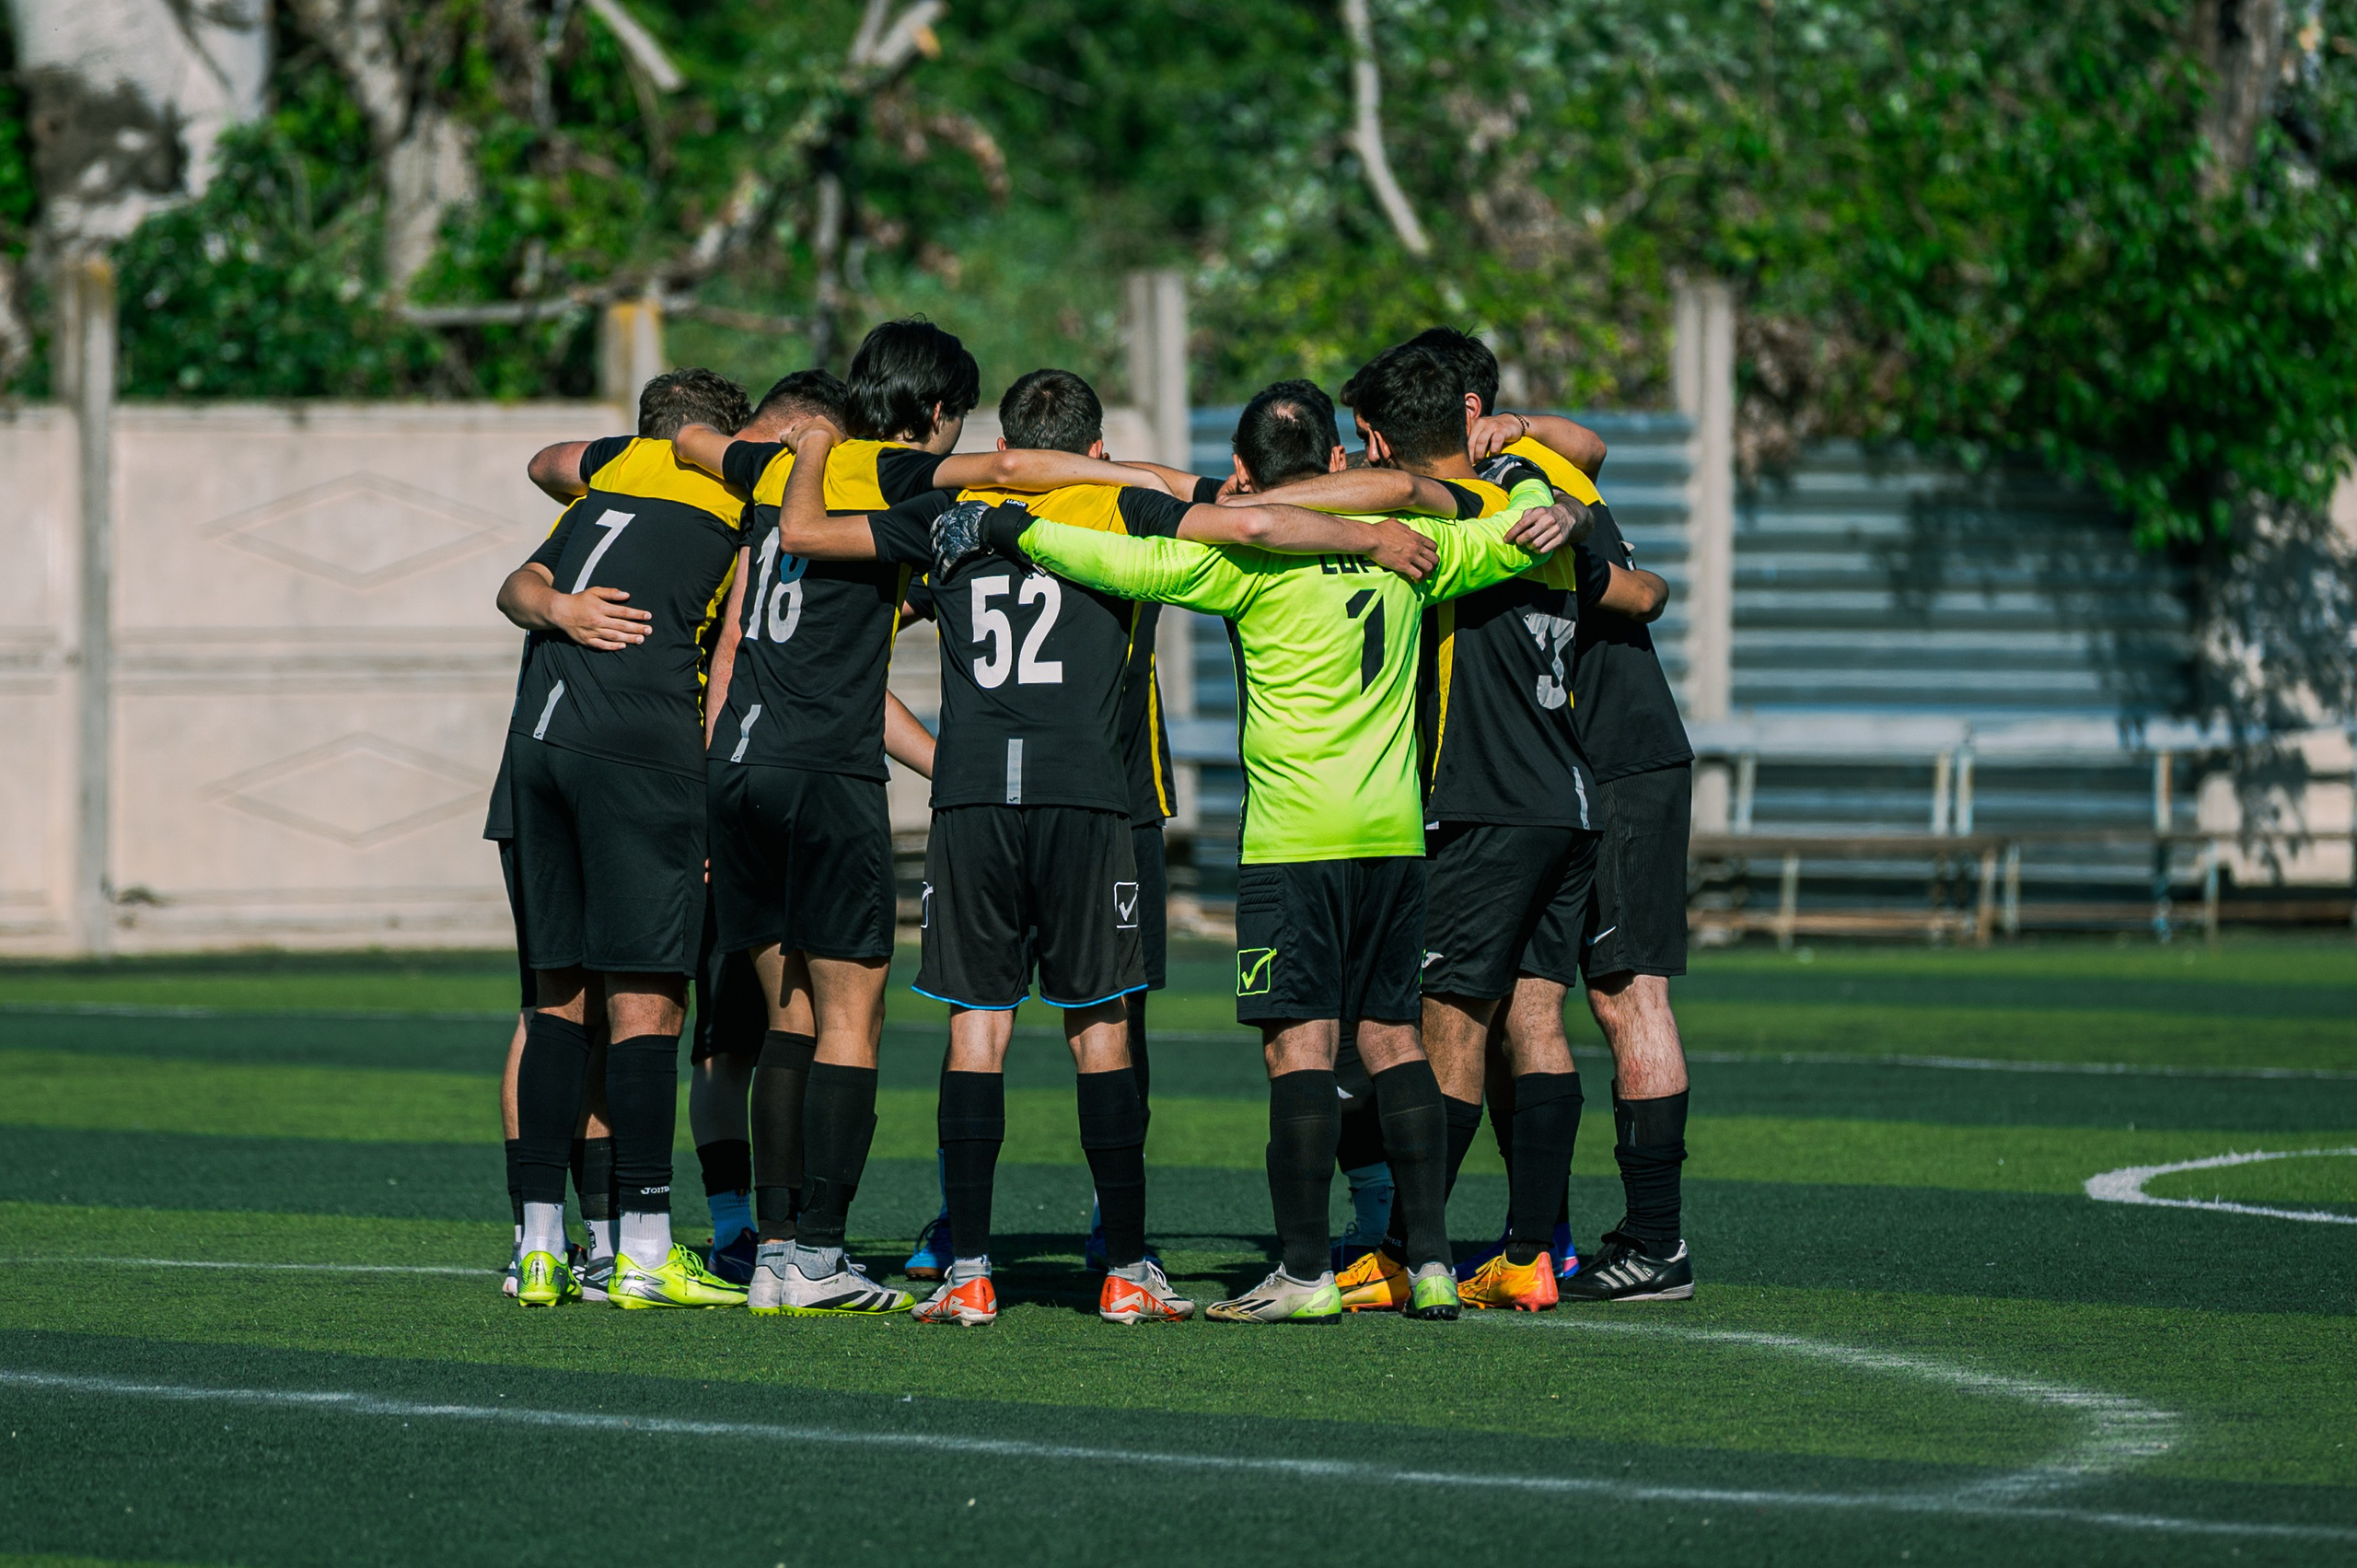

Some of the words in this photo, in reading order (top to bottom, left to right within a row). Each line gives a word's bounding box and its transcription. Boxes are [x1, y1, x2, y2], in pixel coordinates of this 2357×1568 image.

[571, 508, 636, 595] 7
[745, 526, 809, 644] 18
[971, 572, 1062, 689] 52
[1345, 588, 1386, 696] 1
